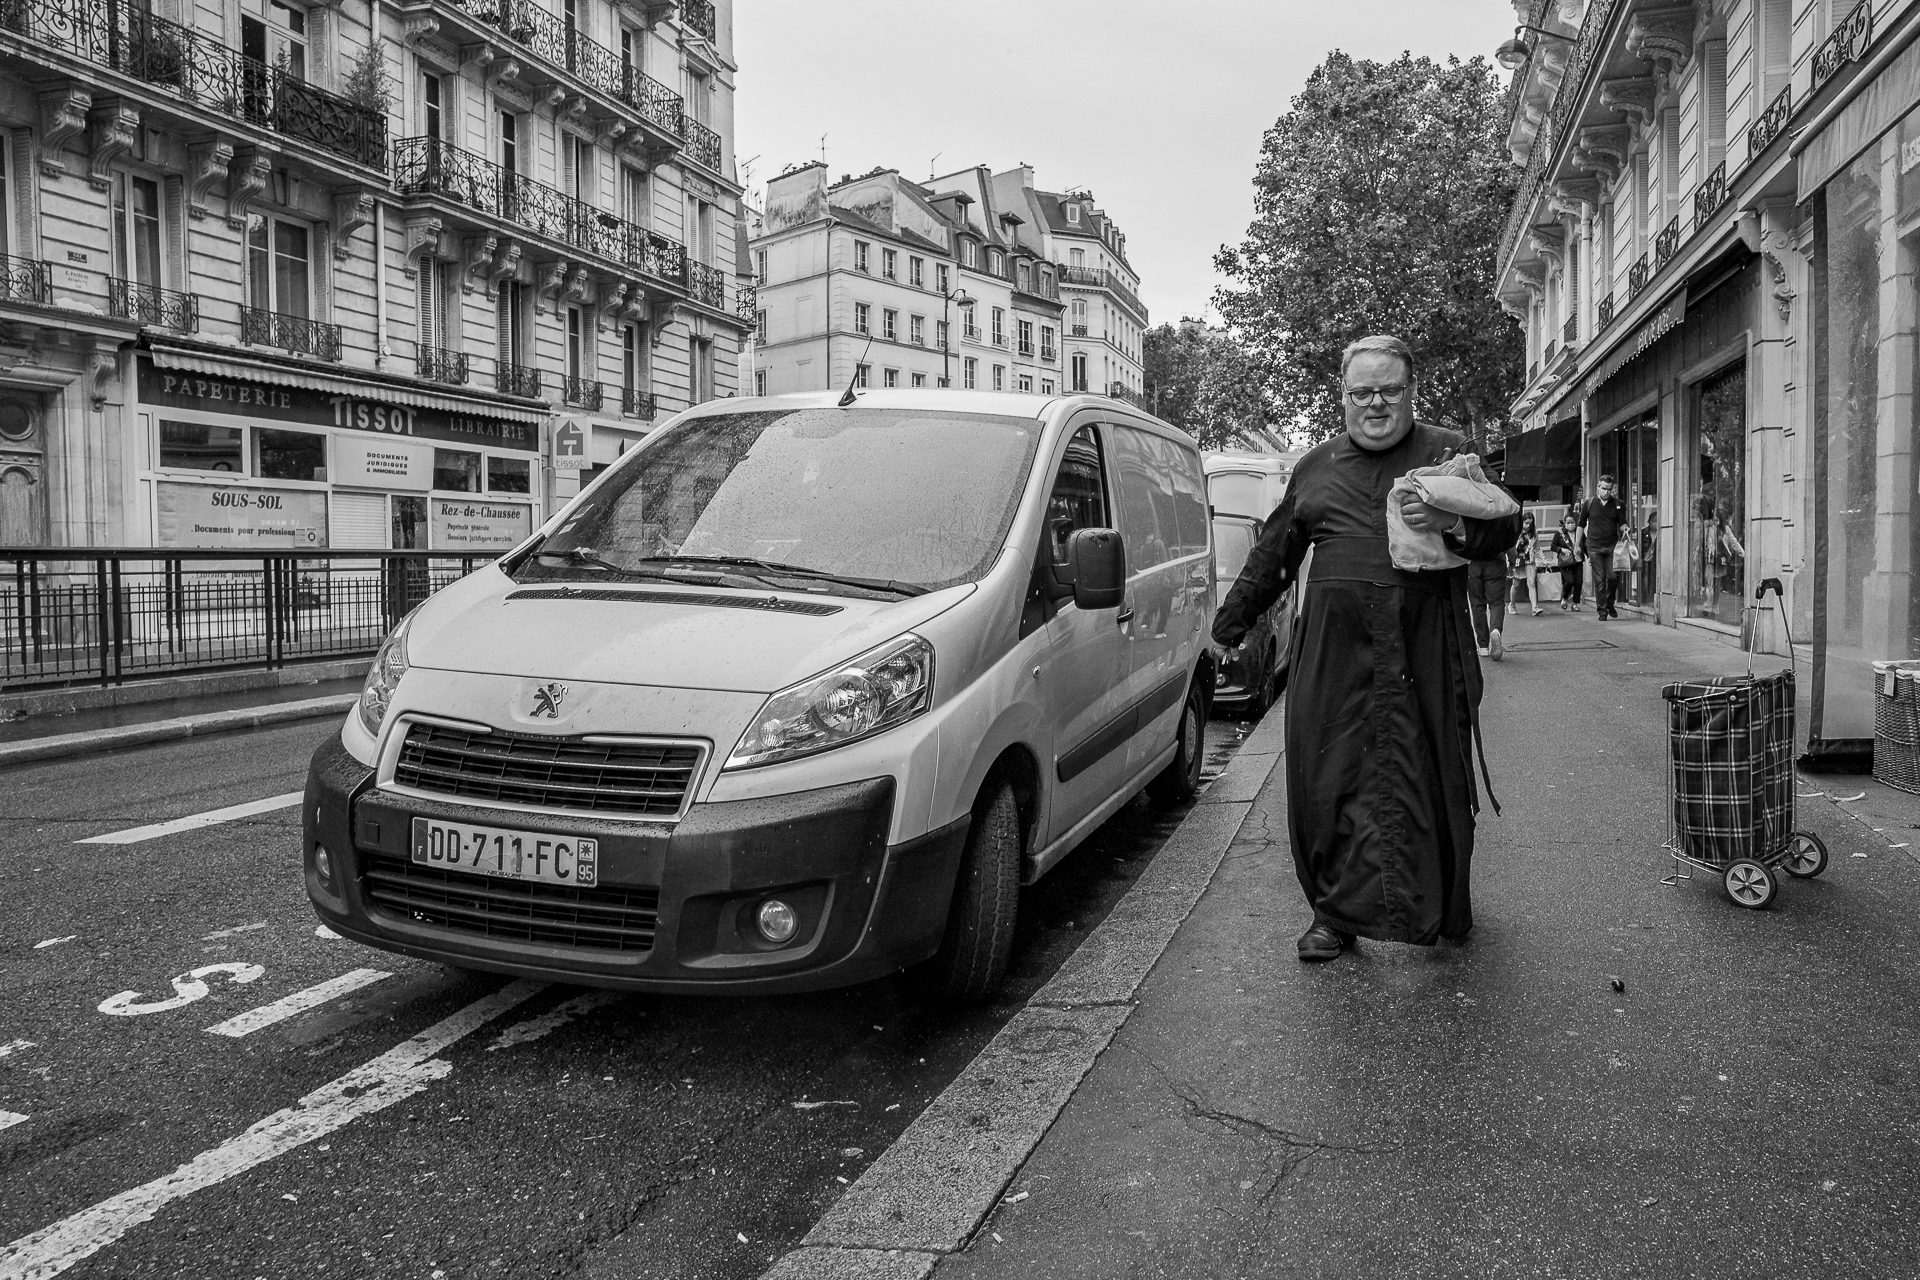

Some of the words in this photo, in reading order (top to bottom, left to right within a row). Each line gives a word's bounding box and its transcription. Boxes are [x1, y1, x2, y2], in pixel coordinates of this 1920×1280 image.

[163, 375, 291, 409] PAPETERIE
[329, 395, 417, 435] TISSOT
[450, 417, 525, 440] LIBRAIRIE
[366, 452, 409, 461] DOCUMENTS
[366, 460, 408, 469] JURIDIQUES
[555, 458, 585, 468] tissot
[372, 468, 408, 476] IMMOBILIERS
[211, 491, 283, 510] SOUS-SOL
[441, 503, 521, 520] Rez-de-Chaussée
[237, 526, 254, 536] pour
[257, 527, 296, 537] professionn
[417, 845, 423, 855] F
[430, 825, 571, 879] DD-711-FC
[578, 864, 594, 882] 95
